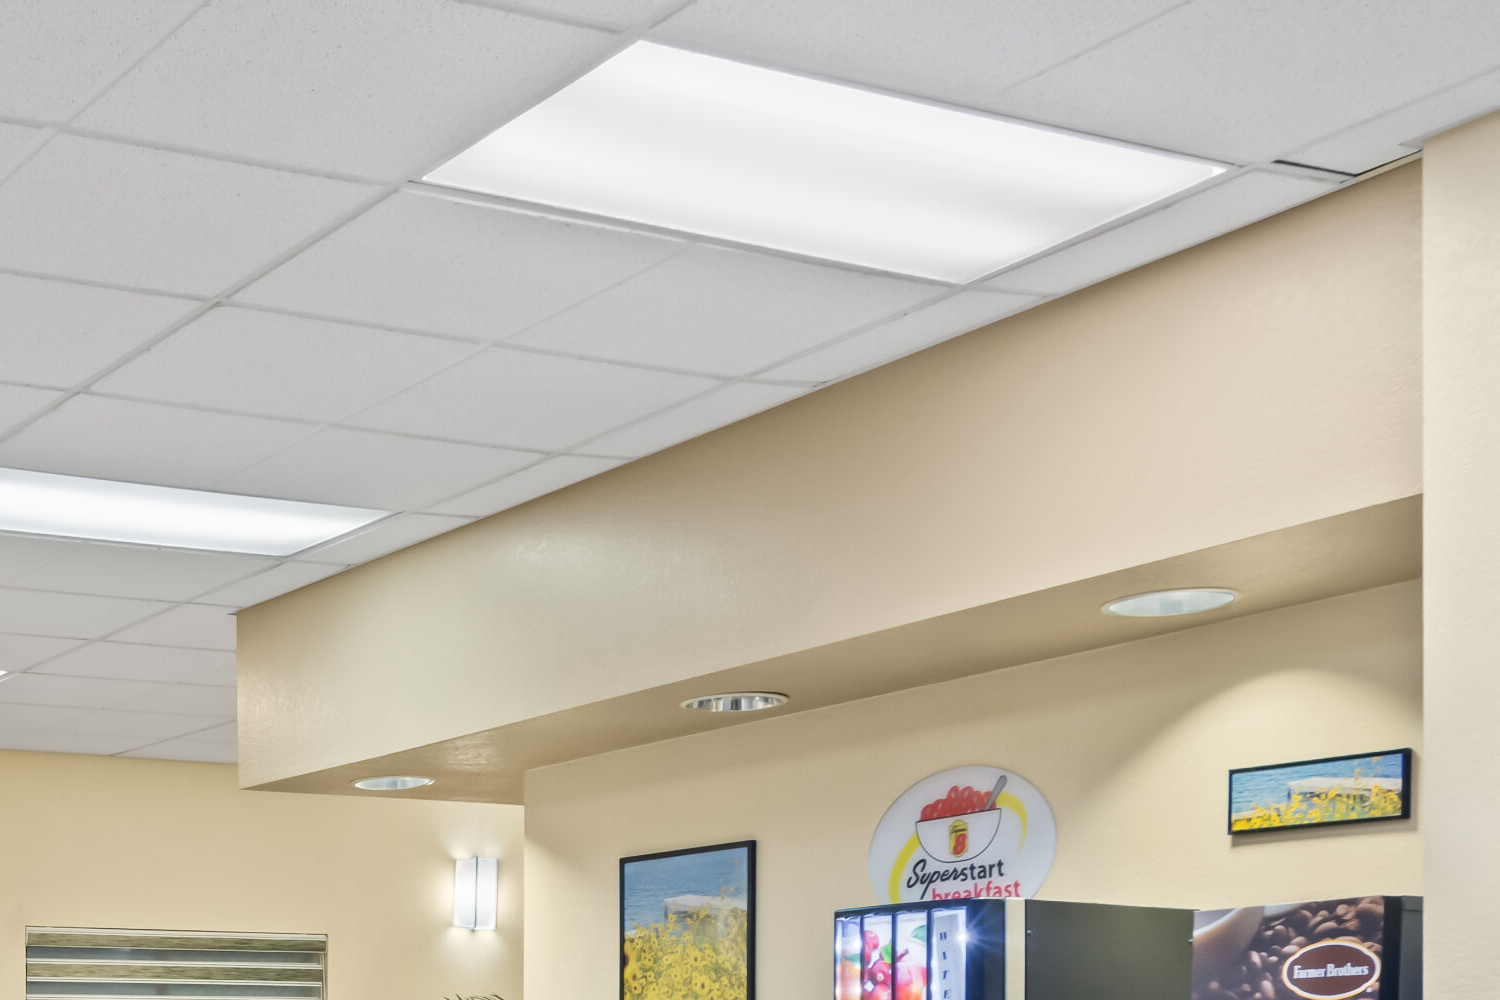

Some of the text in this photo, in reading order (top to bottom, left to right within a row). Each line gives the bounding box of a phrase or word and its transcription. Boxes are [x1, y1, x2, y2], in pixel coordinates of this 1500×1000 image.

[953, 833, 967, 855] 8
[906, 858, 1004, 900] Superstart
[931, 880, 1020, 901] breakfast
[1293, 962, 1370, 979] Farmer Brothers
